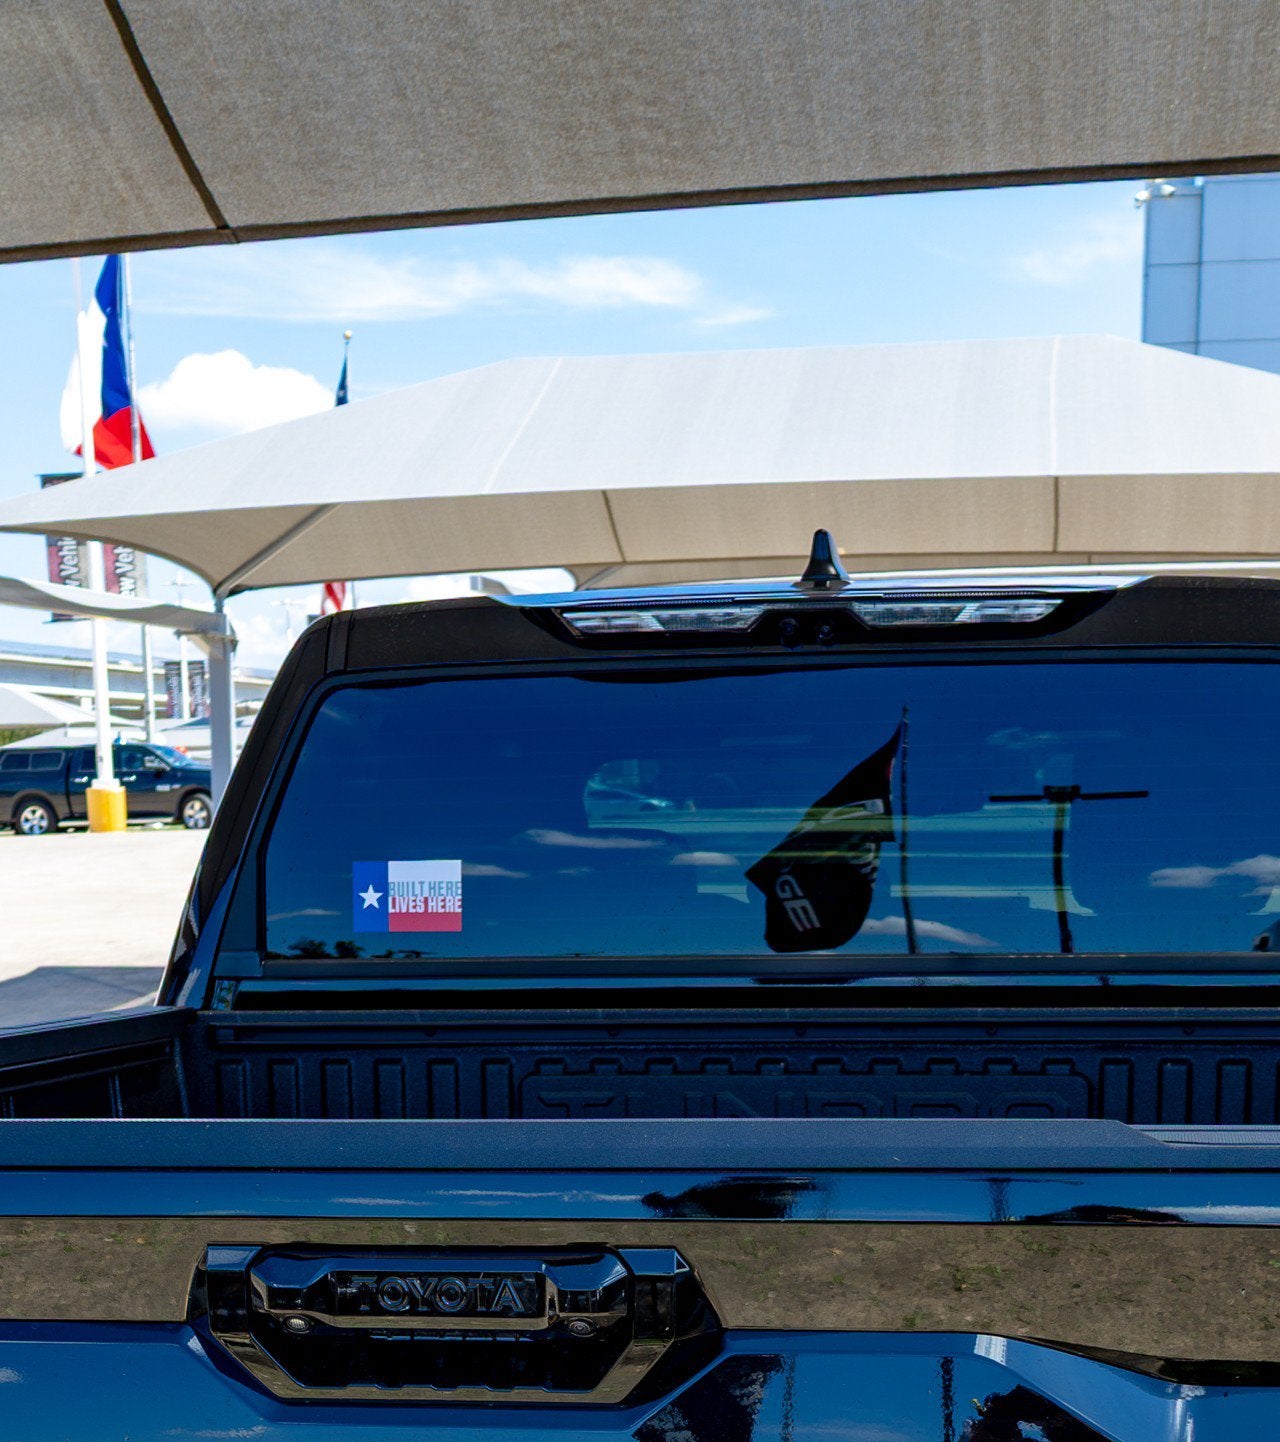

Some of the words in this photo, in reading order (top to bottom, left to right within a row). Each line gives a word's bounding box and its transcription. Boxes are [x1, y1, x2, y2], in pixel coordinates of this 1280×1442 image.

[388, 881, 426, 898] BUILT
[428, 880, 462, 897] HERE
[388, 896, 426, 914] LIVES
[427, 896, 462, 913] HERE
[351, 1275, 526, 1313] TOYOTA
